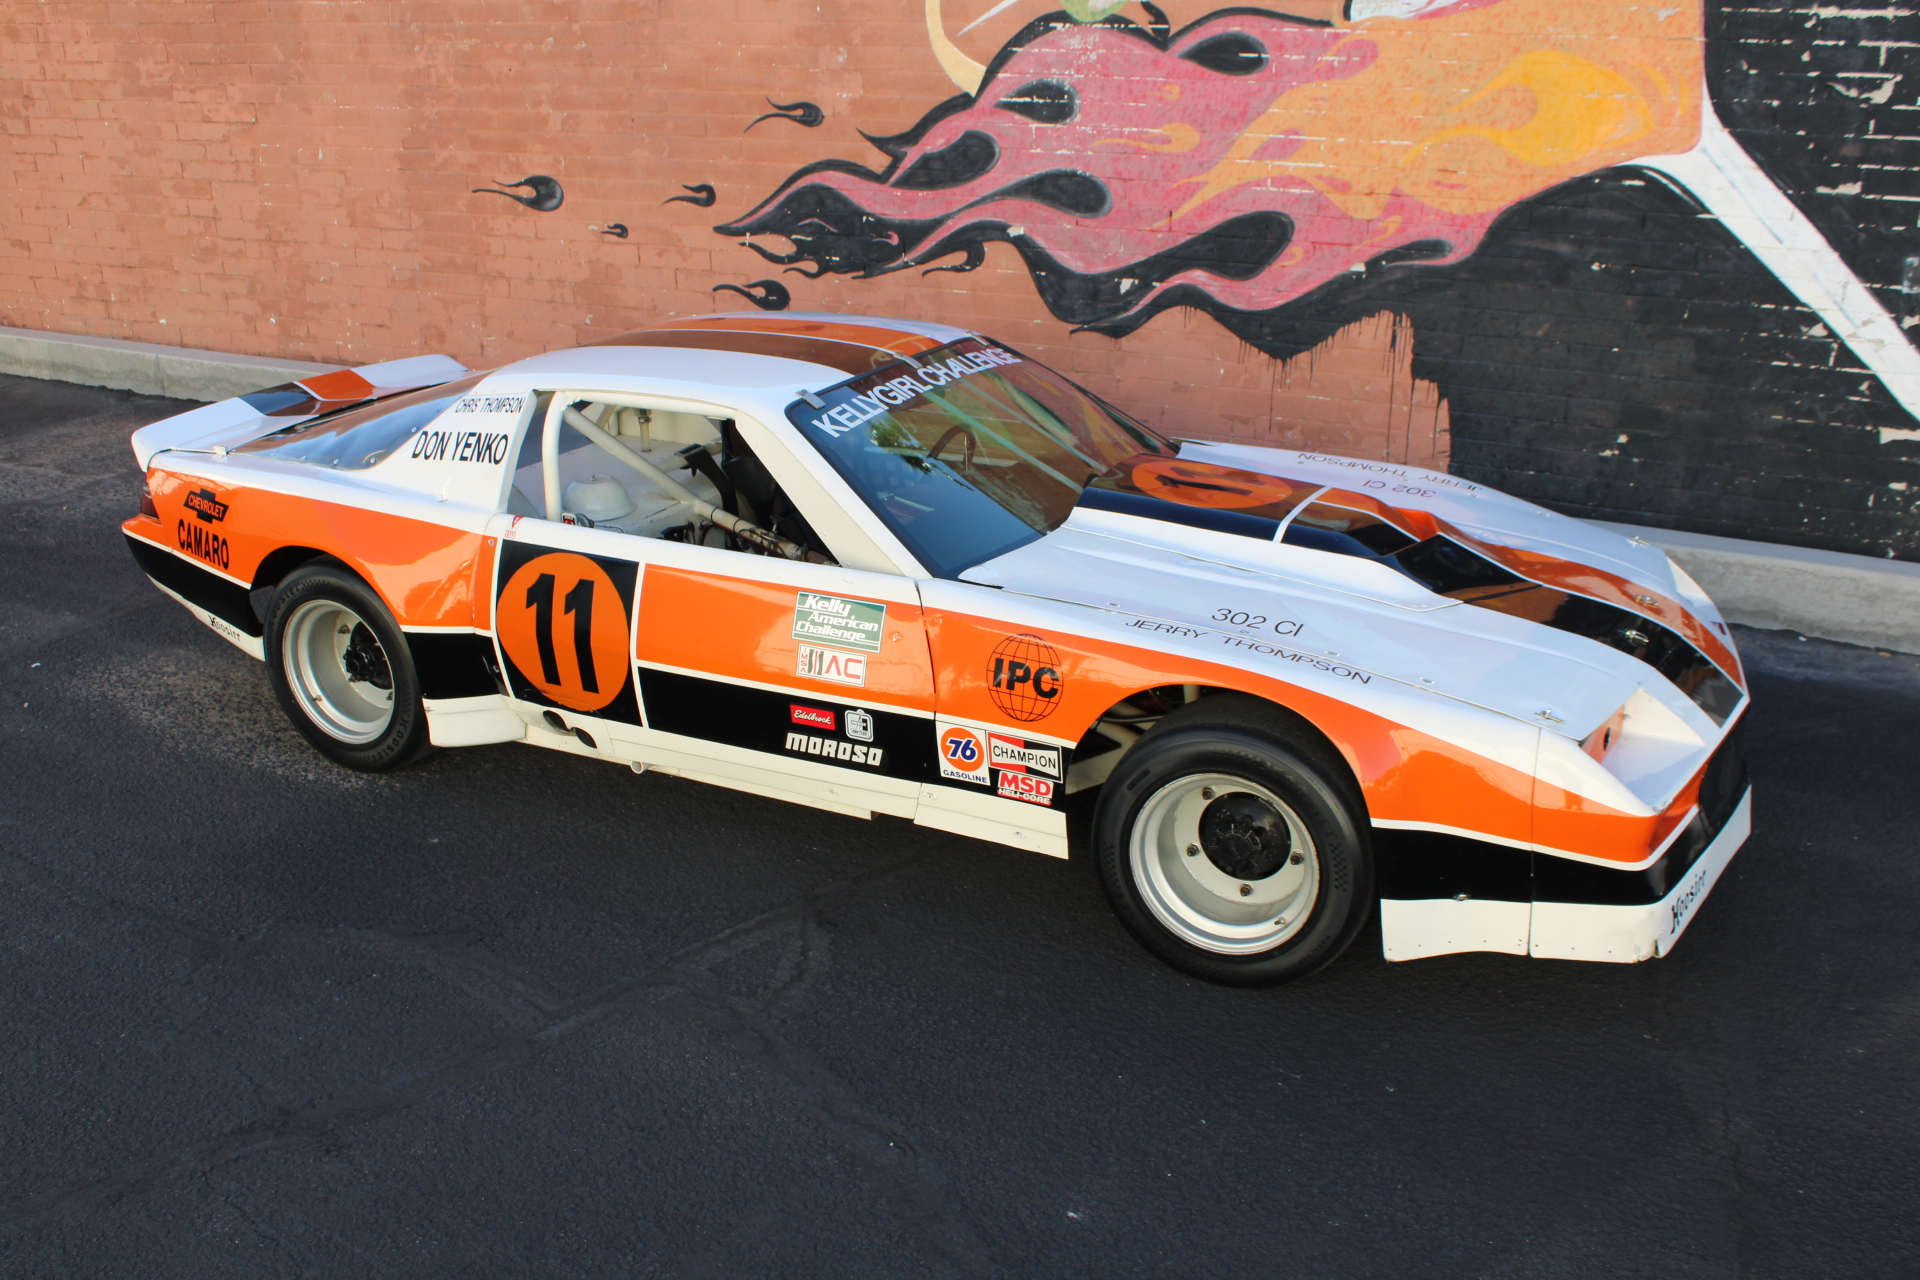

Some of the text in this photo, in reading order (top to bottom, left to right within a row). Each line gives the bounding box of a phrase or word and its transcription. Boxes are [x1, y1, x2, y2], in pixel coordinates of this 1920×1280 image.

[917, 348, 1023, 387] CHALLENGE
[455, 397, 527, 413] CHRIS THOMPSON
[411, 430, 509, 465] DON YENKO
[1154, 466, 1267, 496] 11
[1297, 453, 1484, 491] JERRY THOMPSON
[1362, 479, 1437, 498] 302 CI
[187, 494, 225, 519] CHEVROLET
[177, 518, 230, 571] CAMARO
[804, 595, 852, 617] Kelly
[525, 572, 600, 694] 11
[795, 620, 866, 643] Challenge
[808, 611, 879, 632] American
[1211, 608, 1305, 637] 302 CI
[800, 648, 808, 673] IMSA
[1125, 619, 1372, 685] JERRY THOMPSON
[992, 657, 1060, 699] IPC
[793, 709, 832, 725] Edelbrock
[785, 732, 883, 766] MOROSO
[946, 737, 979, 762] 76
[992, 745, 1056, 770] CHAMPION
[943, 769, 988, 784] GASOLINE
[1000, 771, 1051, 796] MSD
